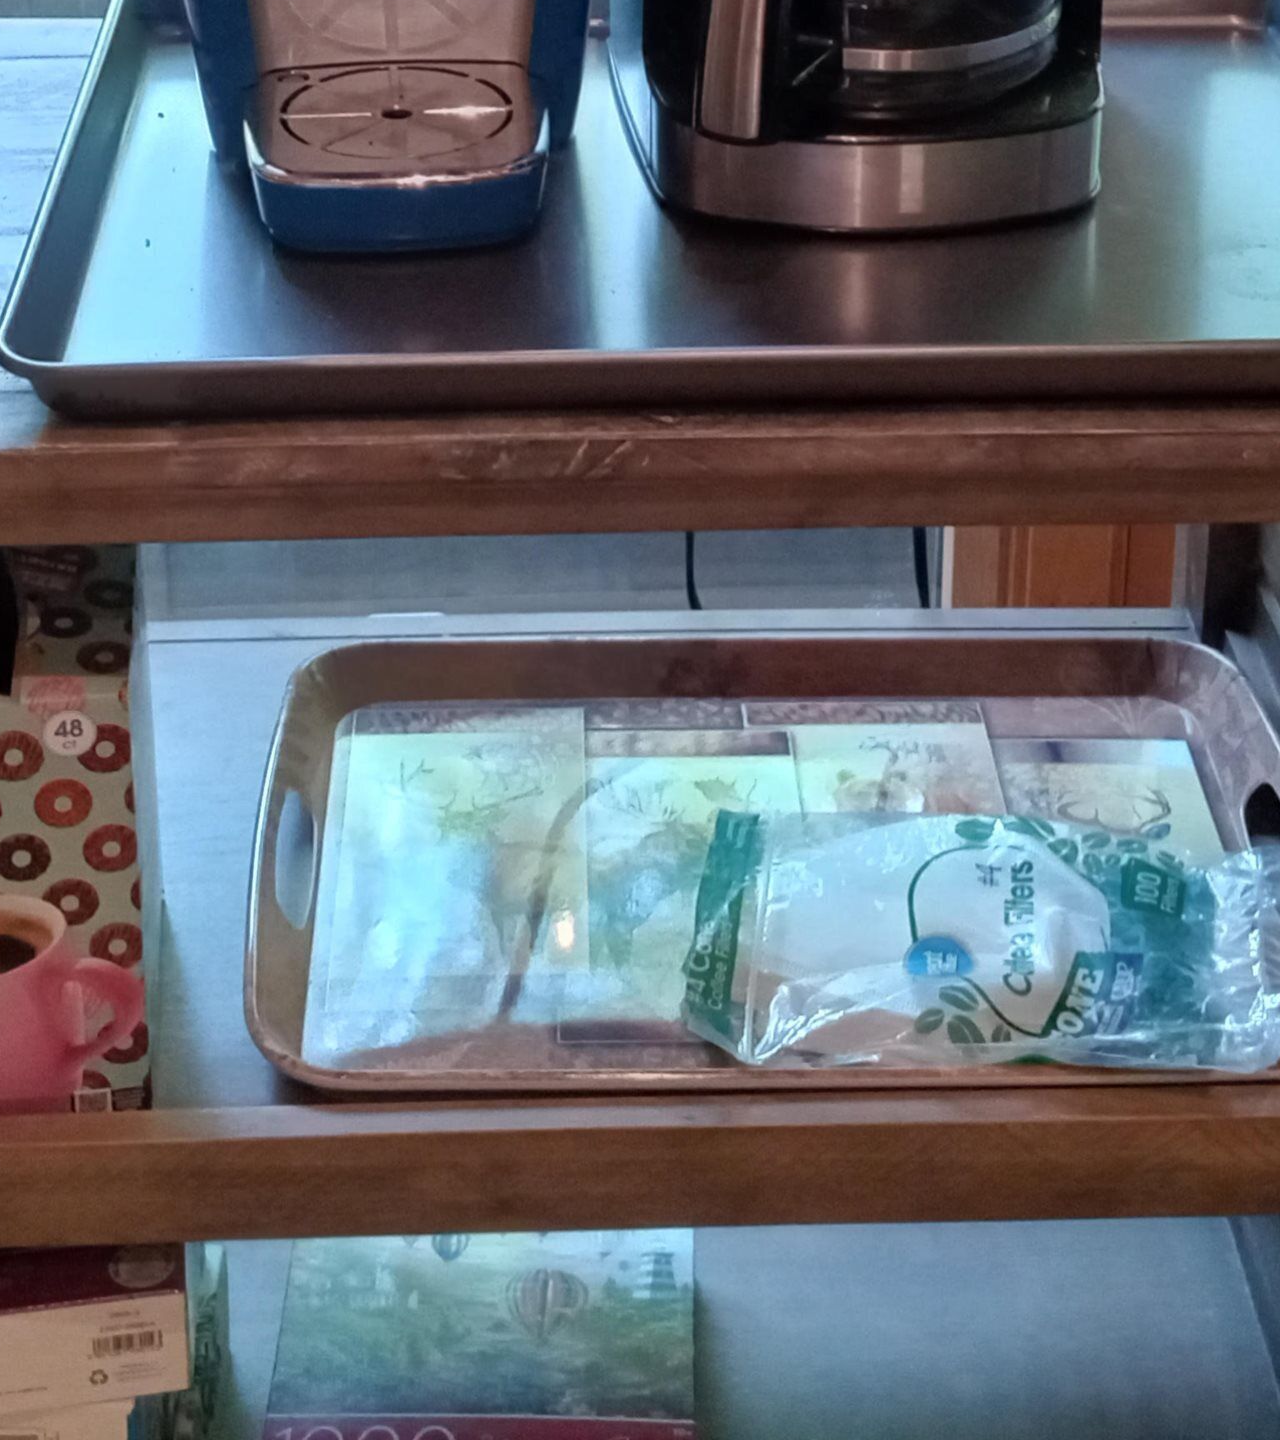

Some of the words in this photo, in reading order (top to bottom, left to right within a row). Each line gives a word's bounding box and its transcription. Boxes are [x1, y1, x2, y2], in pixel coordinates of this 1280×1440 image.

[54, 718, 85, 738] 48
[1004, 860, 1035, 926] Filters
[1134, 872, 1161, 905] 100
